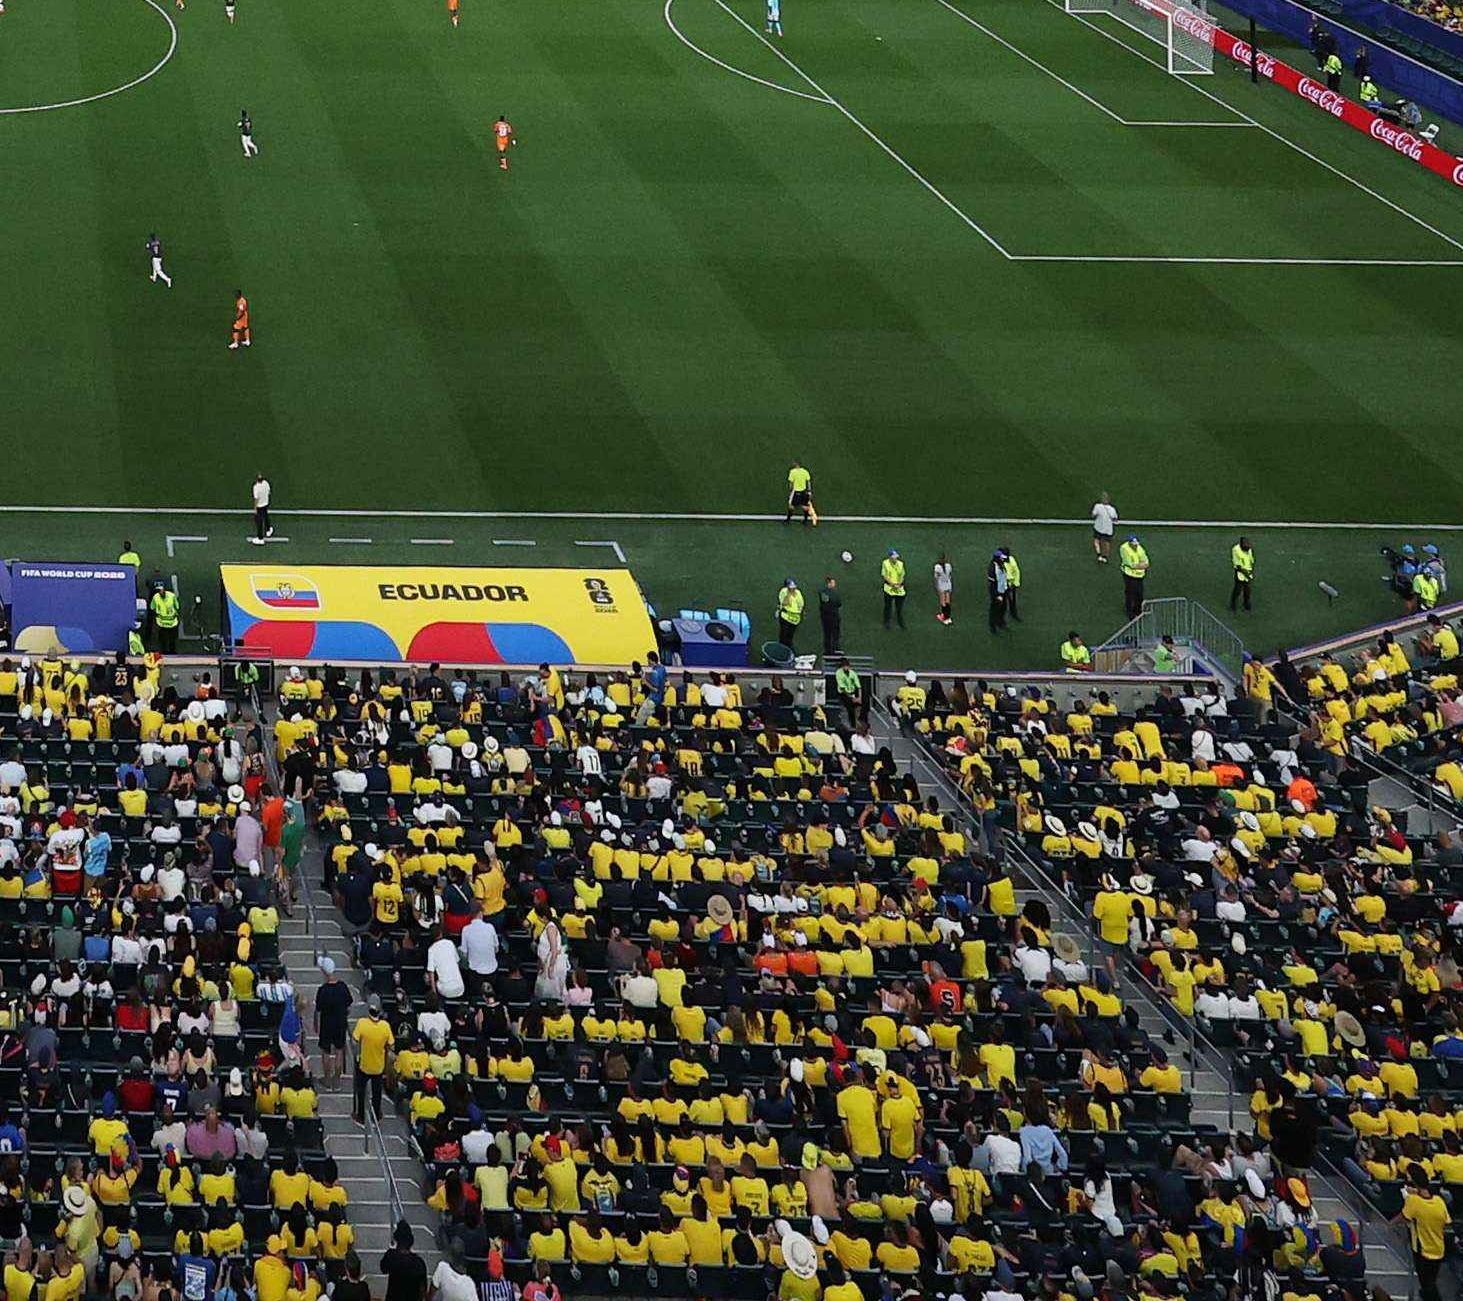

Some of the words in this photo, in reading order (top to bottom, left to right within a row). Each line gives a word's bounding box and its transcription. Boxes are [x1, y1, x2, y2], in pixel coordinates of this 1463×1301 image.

[21, 569, 39, 577] FIFA
[40, 570, 73, 578] WORLD
[74, 570, 93, 578] CUP
[378, 583, 529, 602] ECUADOR
[384, 899, 395, 915] 12
